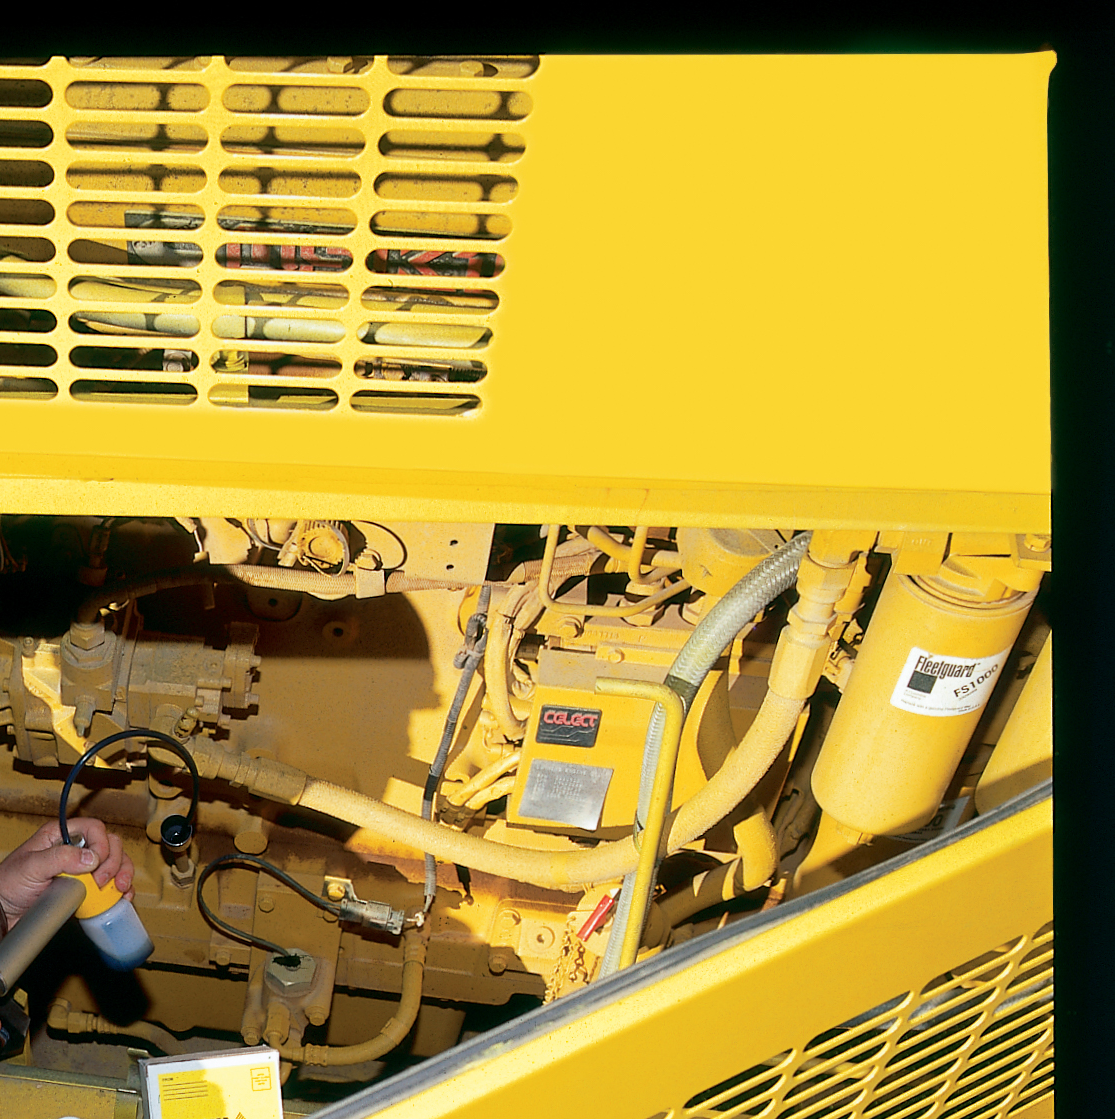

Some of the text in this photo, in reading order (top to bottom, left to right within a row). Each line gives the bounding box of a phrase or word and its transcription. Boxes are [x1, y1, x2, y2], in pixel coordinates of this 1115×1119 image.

[914, 655, 977, 679] Fleetguard
[953, 663, 999, 698] FS1000
[543, 710, 599, 728] CELECT
